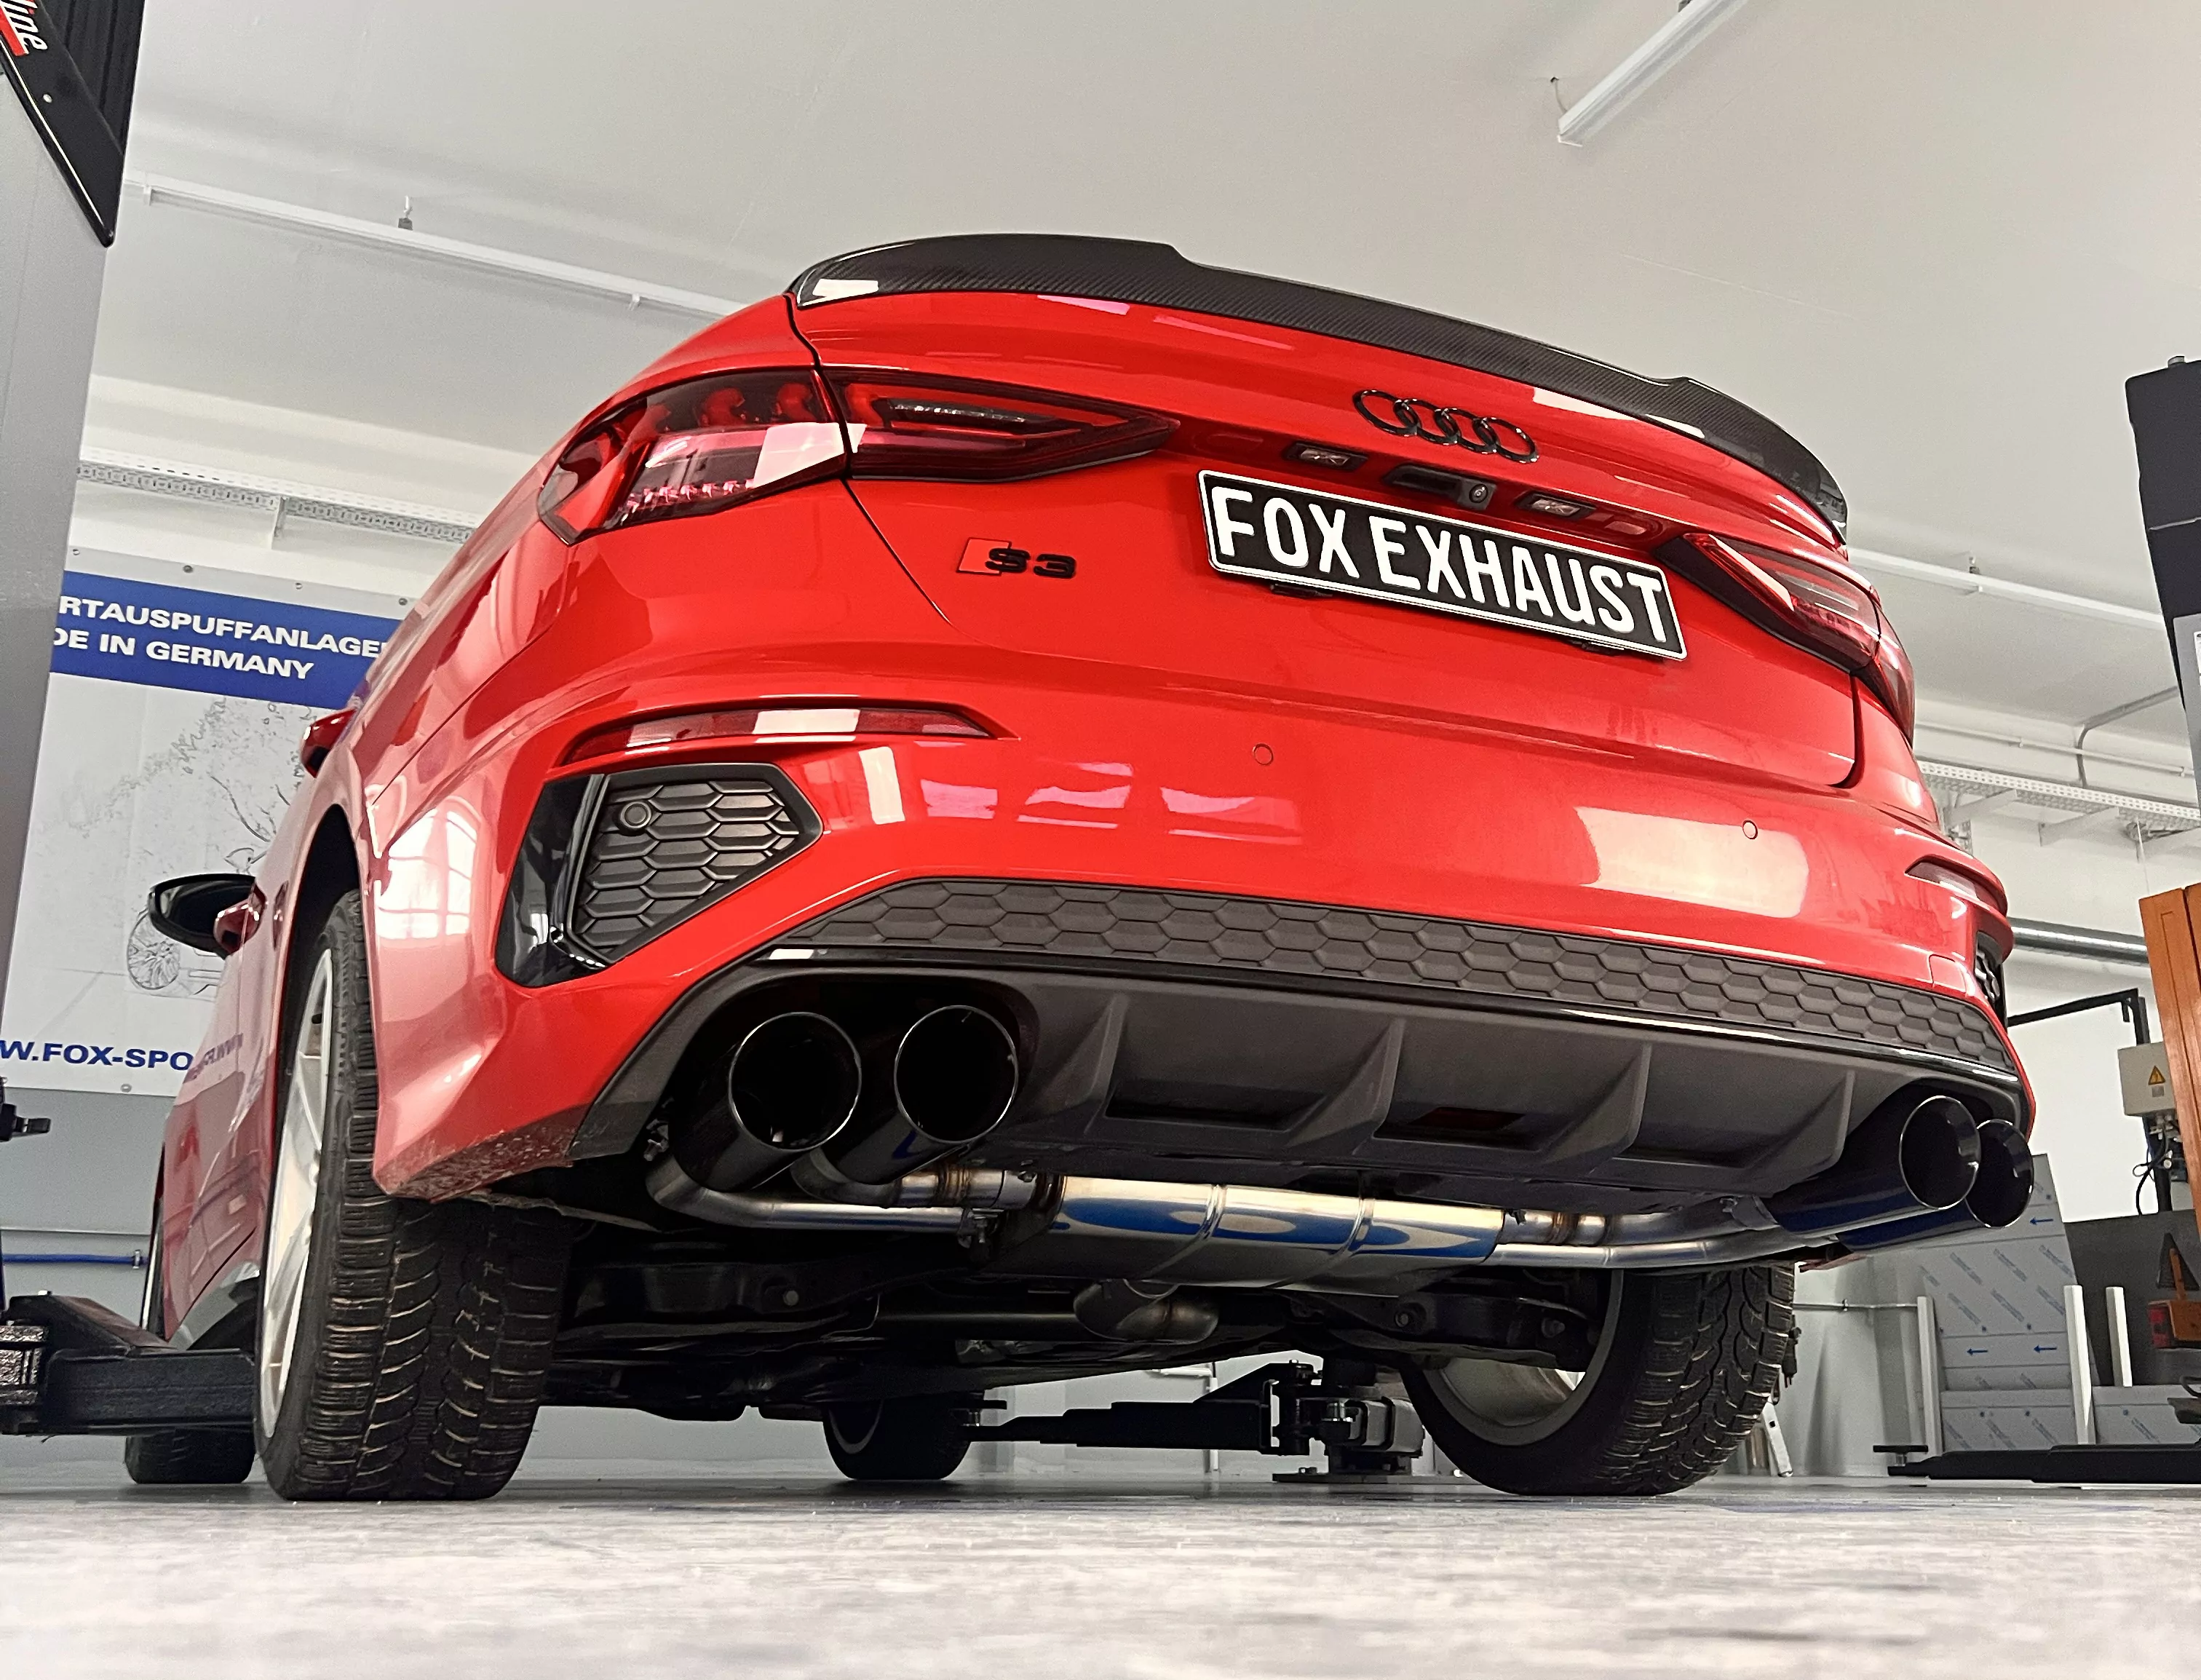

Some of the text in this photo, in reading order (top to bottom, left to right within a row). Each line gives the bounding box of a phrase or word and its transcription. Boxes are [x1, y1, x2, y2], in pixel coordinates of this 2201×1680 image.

[985, 547, 1077, 579] S3
[1210, 485, 1667, 643] FOX EXHAUST
[59, 595, 389, 658] RTAUSPUFFANLAGE
[99, 634, 135, 655] IN
[146, 641, 314, 679] GERMANY
